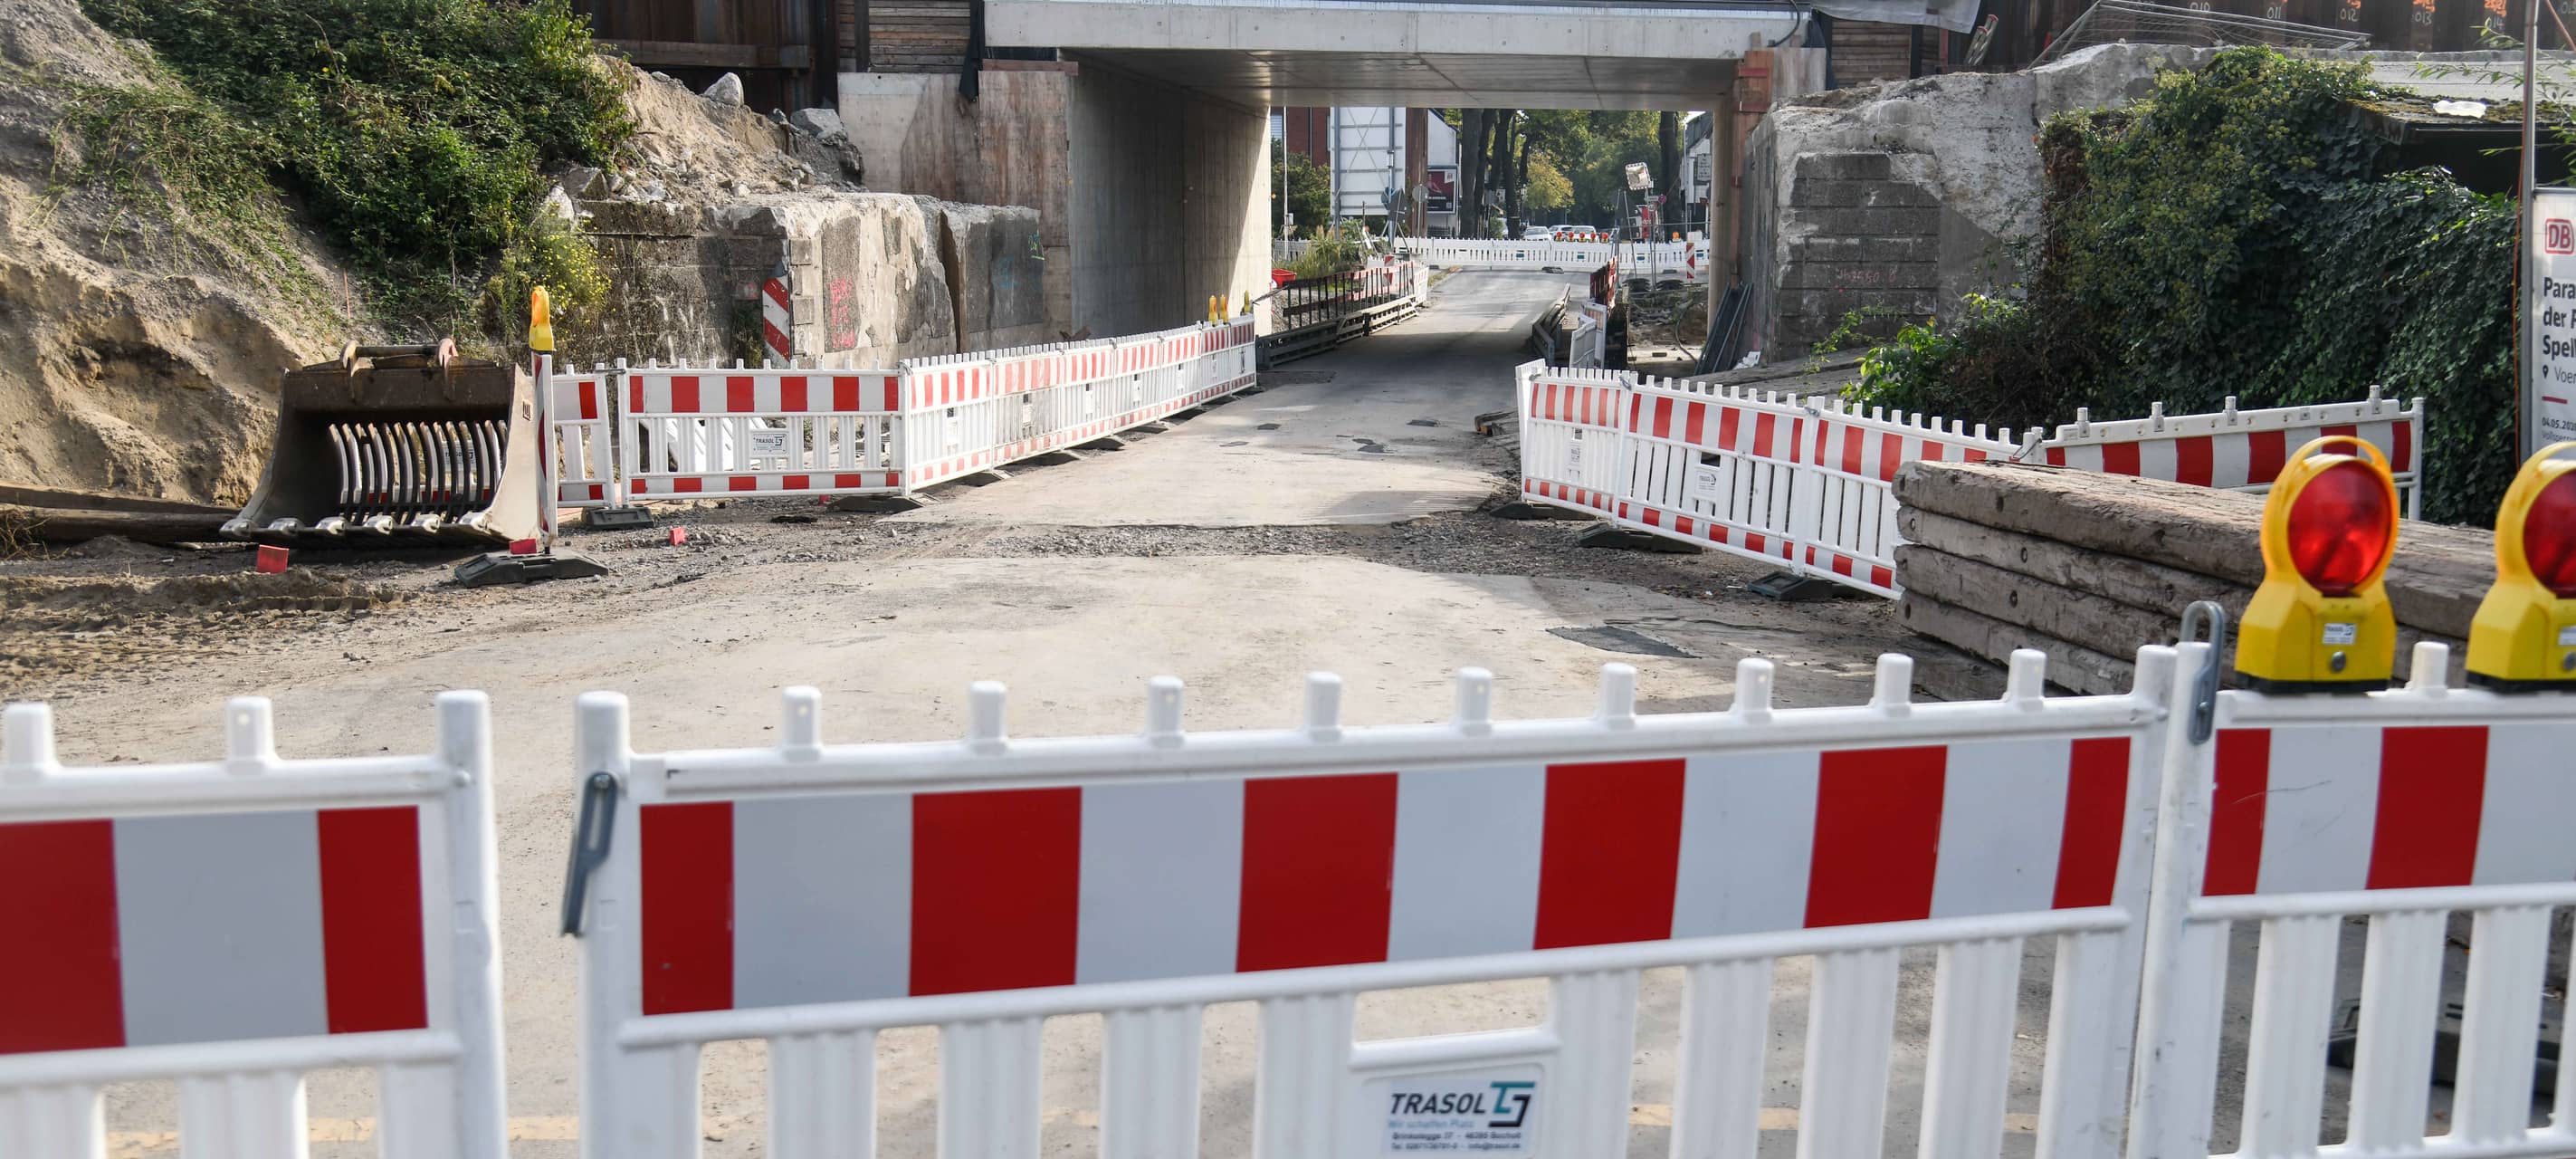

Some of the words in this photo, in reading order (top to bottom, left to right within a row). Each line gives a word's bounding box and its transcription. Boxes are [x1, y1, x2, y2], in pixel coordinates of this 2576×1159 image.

[2548, 225, 2571, 249] DB
[2543, 276, 2576, 300] Para
[2543, 306, 2567, 327] der
[1391, 1093, 1486, 1115] TRASOL
